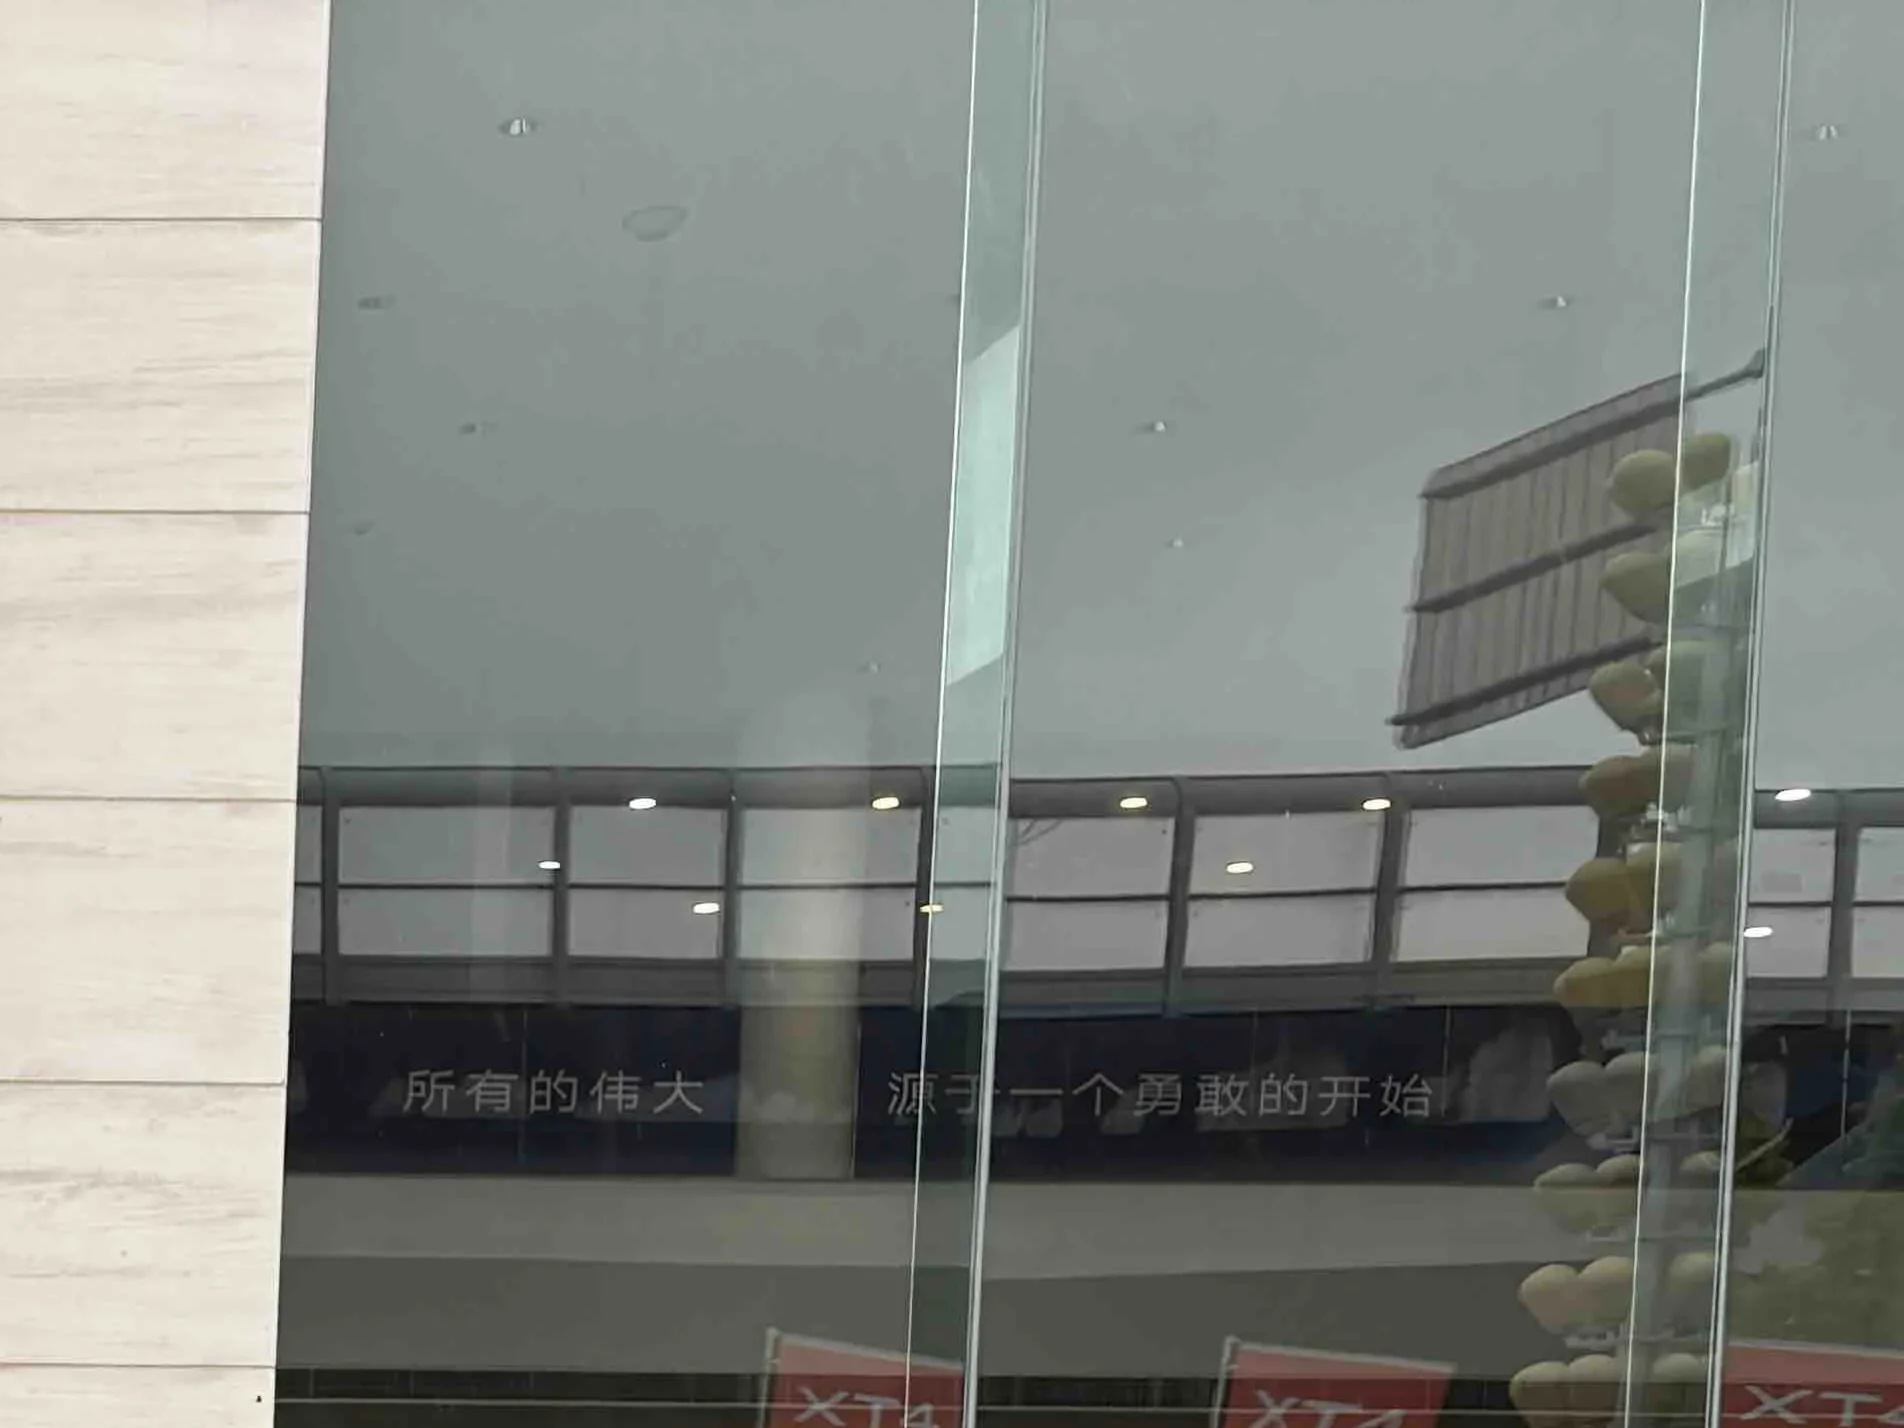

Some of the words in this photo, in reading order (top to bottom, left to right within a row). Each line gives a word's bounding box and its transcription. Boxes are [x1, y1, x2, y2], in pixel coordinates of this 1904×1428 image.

[403, 1069, 704, 1115] 所有的伟大
[887, 1070, 1435, 1118] 源于一个勇敢的开始
